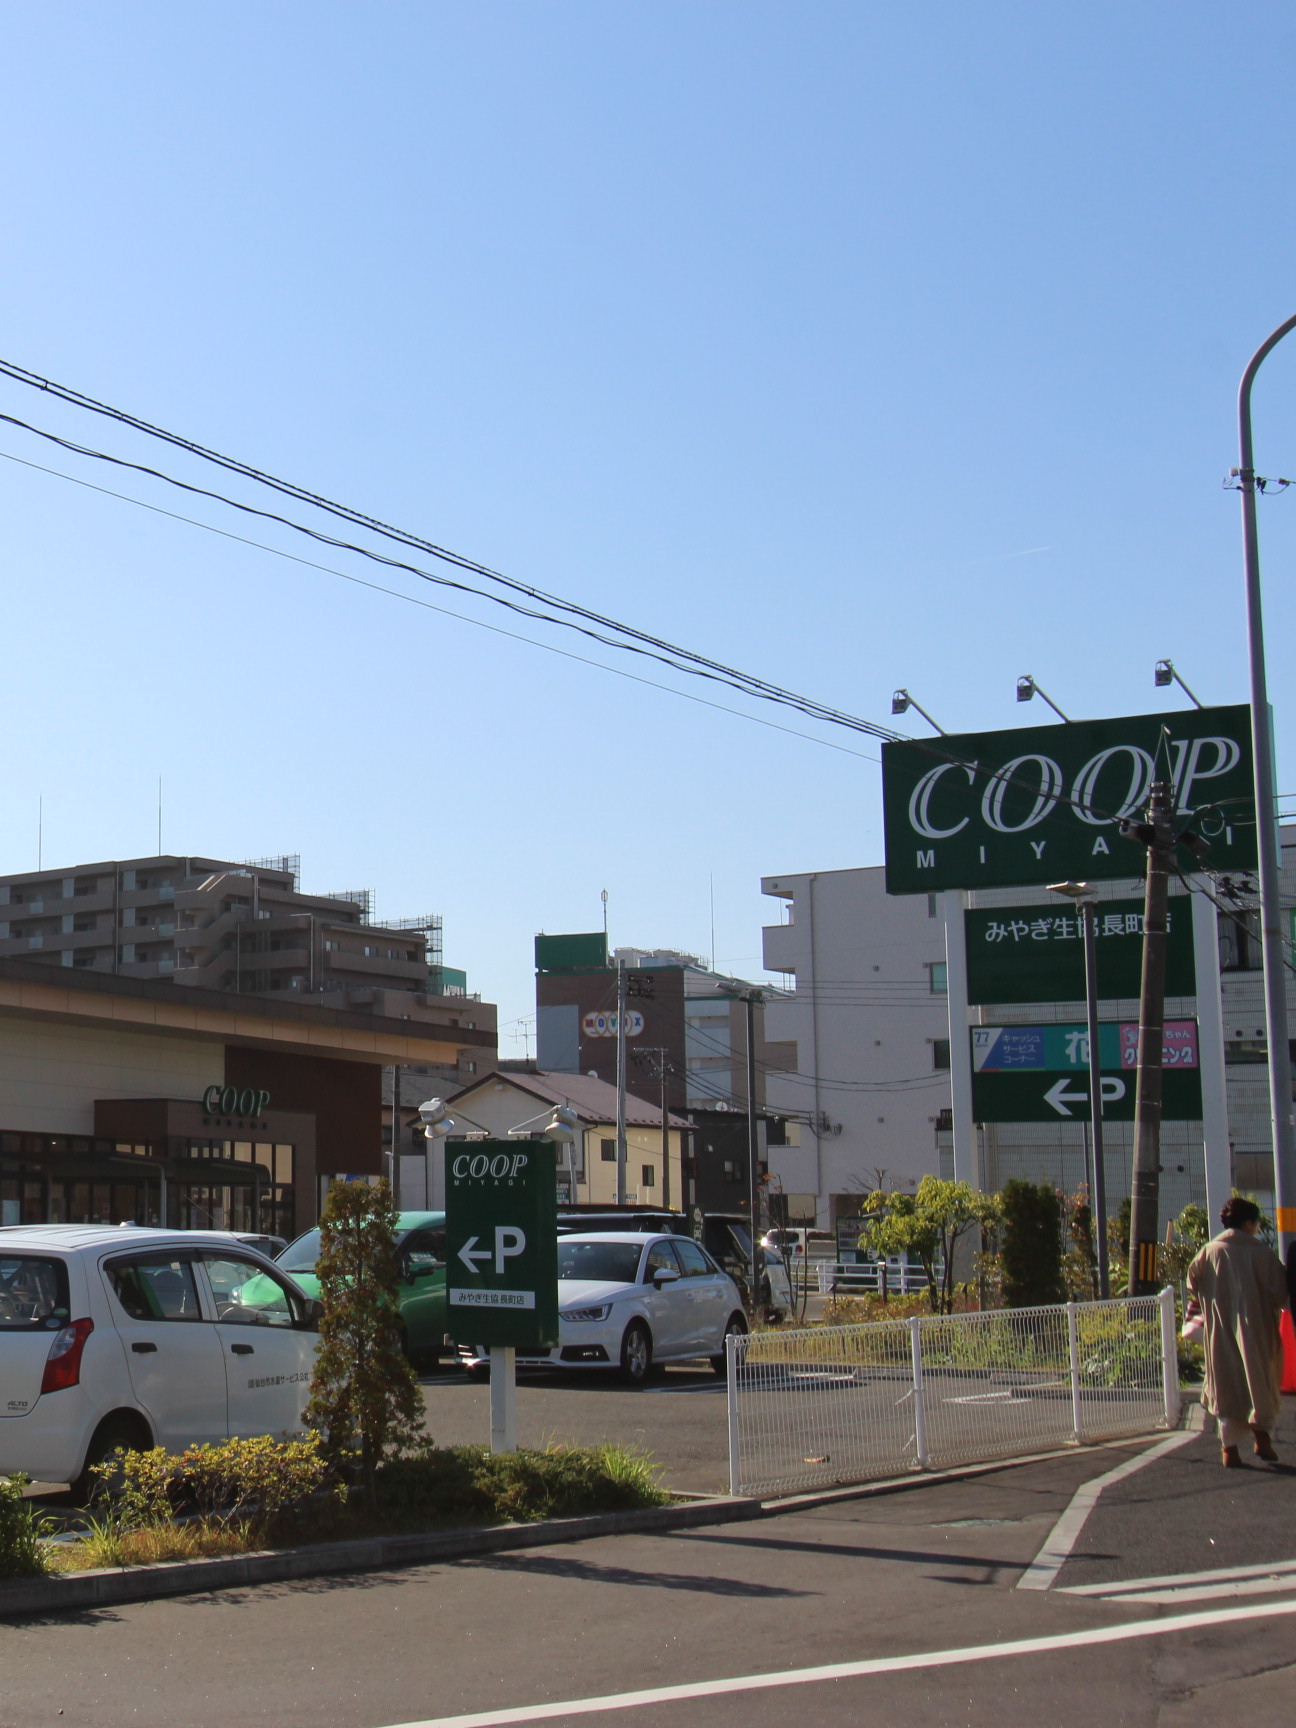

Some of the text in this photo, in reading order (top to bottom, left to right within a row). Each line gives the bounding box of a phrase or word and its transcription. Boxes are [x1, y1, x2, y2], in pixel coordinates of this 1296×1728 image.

[909, 736, 1240, 839] COOP
[917, 826, 1232, 869] MIYAI
[985, 912, 1171, 943] みやぎ生協長町
[974, 1031, 990, 1043] 77
[1003, 1034, 1041, 1043] キャッシュ
[1003, 1044, 1036, 1053] サービス
[1065, 1030, 1090, 1064] 花
[1004, 1055, 1036, 1064] コーナー
[203, 1085, 270, 1118] COOP
[452, 1154, 528, 1178] COOP
[495, 1226, 526, 1274] P
